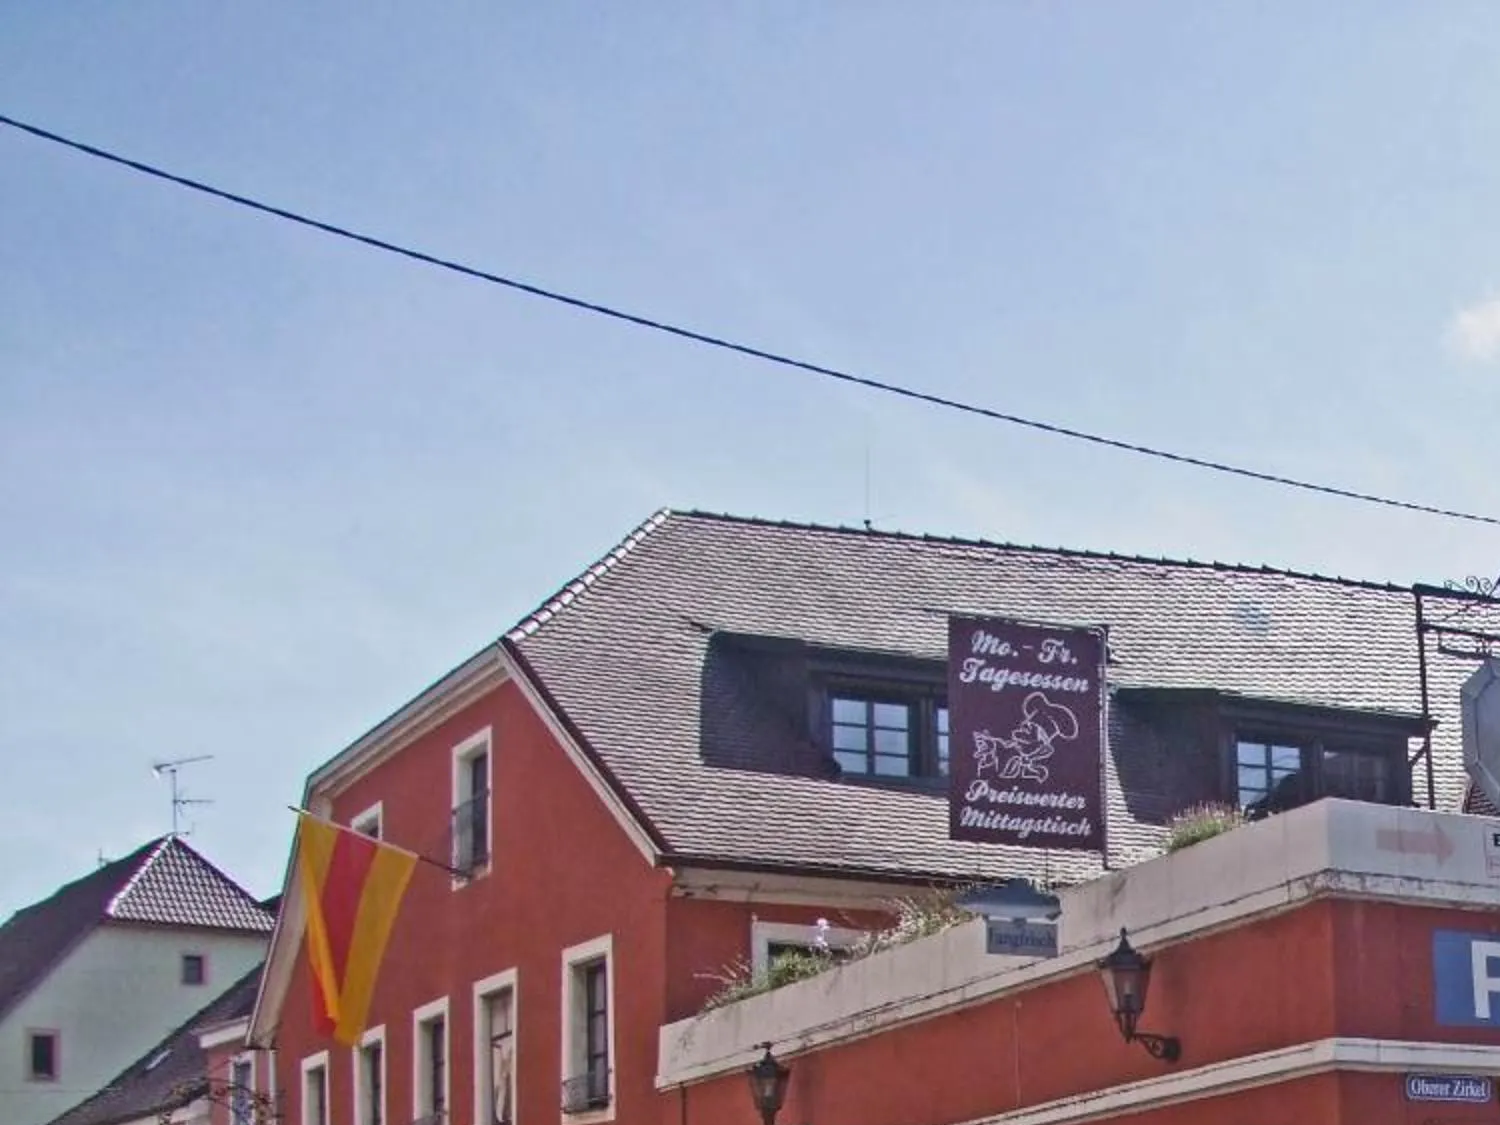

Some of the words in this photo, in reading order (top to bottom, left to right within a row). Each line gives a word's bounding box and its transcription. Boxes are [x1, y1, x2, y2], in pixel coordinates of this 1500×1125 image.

[971, 629, 1019, 657] Mo.
[1037, 638, 1078, 664] Fr.
[959, 657, 1089, 692] Tagesessen
[965, 778, 1087, 810] Preiswerter
[959, 805, 1092, 839] Mittagstisch
[1410, 1079, 1450, 1097] Oberer
[1452, 1079, 1486, 1098] Zirkel
